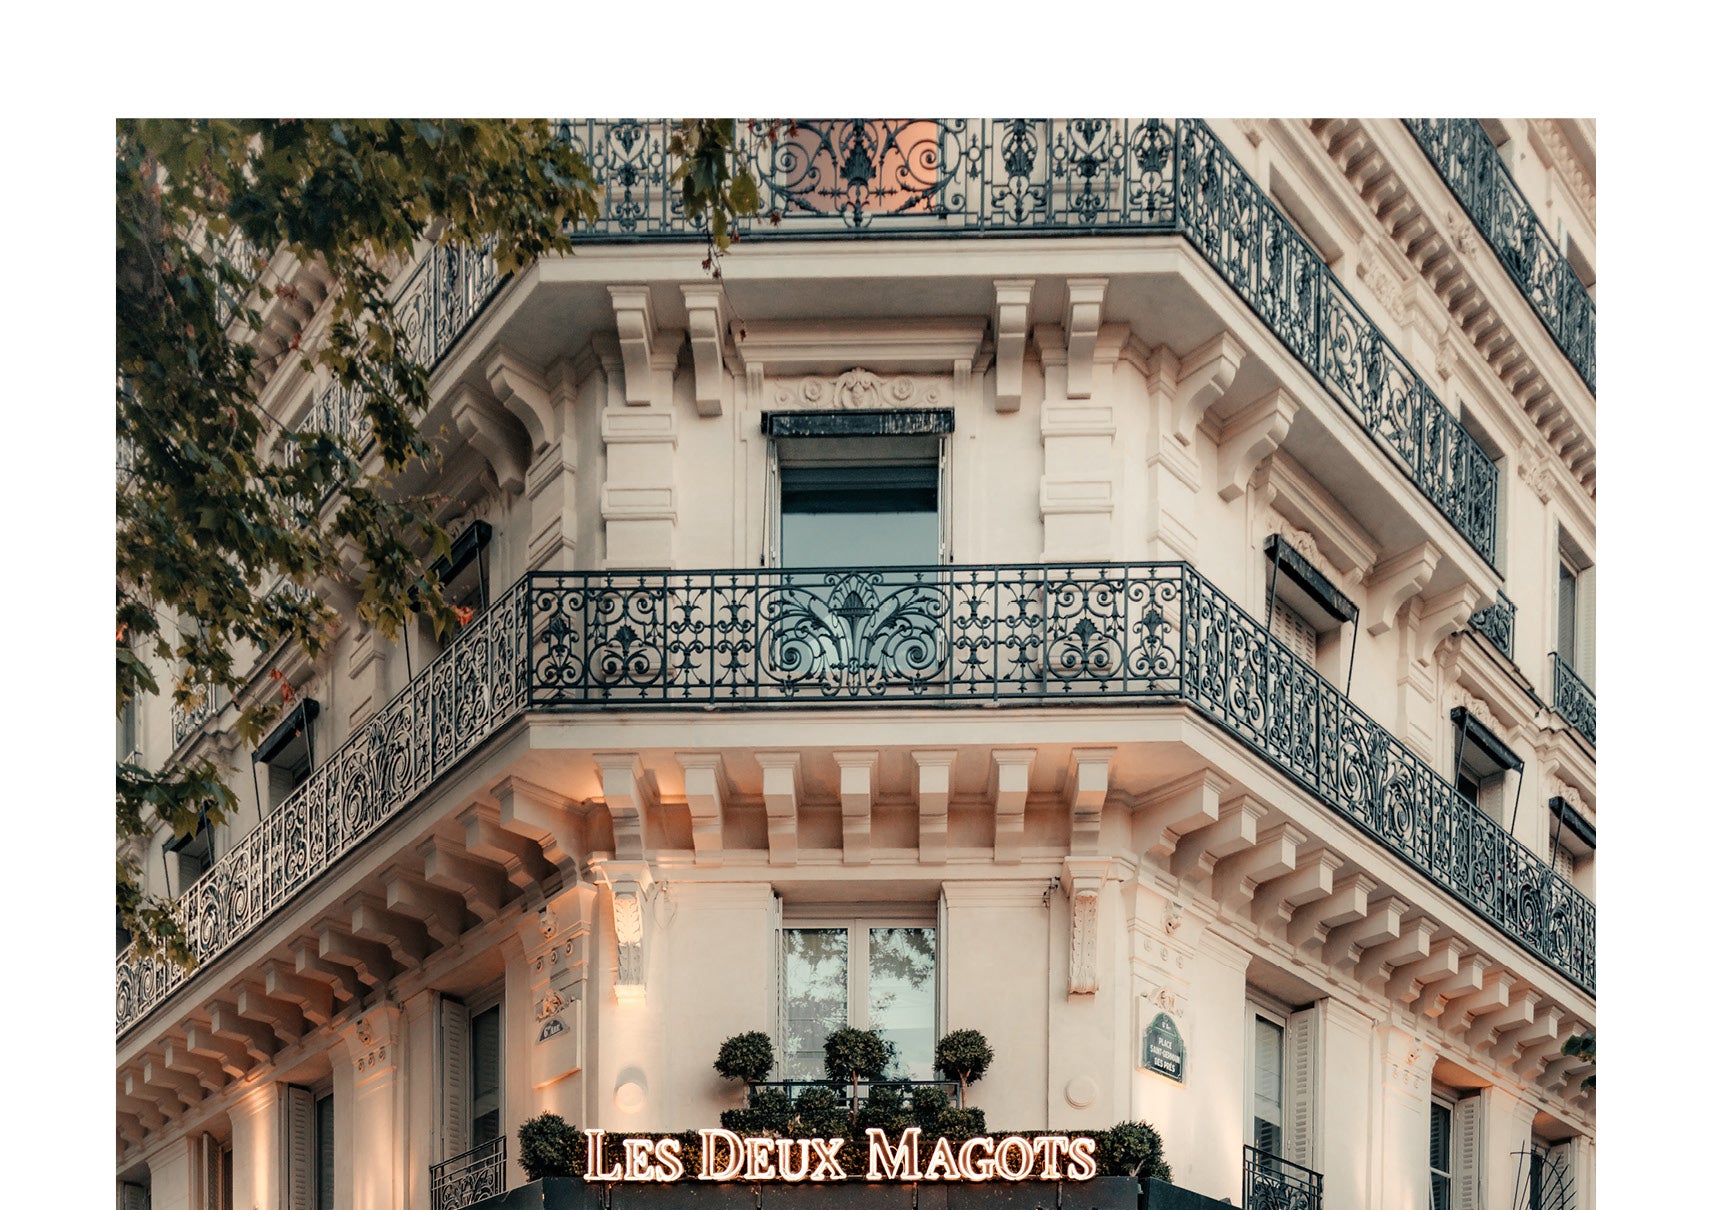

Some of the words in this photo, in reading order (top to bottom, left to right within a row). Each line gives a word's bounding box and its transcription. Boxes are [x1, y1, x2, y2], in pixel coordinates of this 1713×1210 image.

[1158, 1037, 1172, 1049] PLACE
[583, 1128, 684, 1181] LES
[698, 1128, 847, 1182] DEUX
[865, 1127, 1097, 1181] MAGOTS
